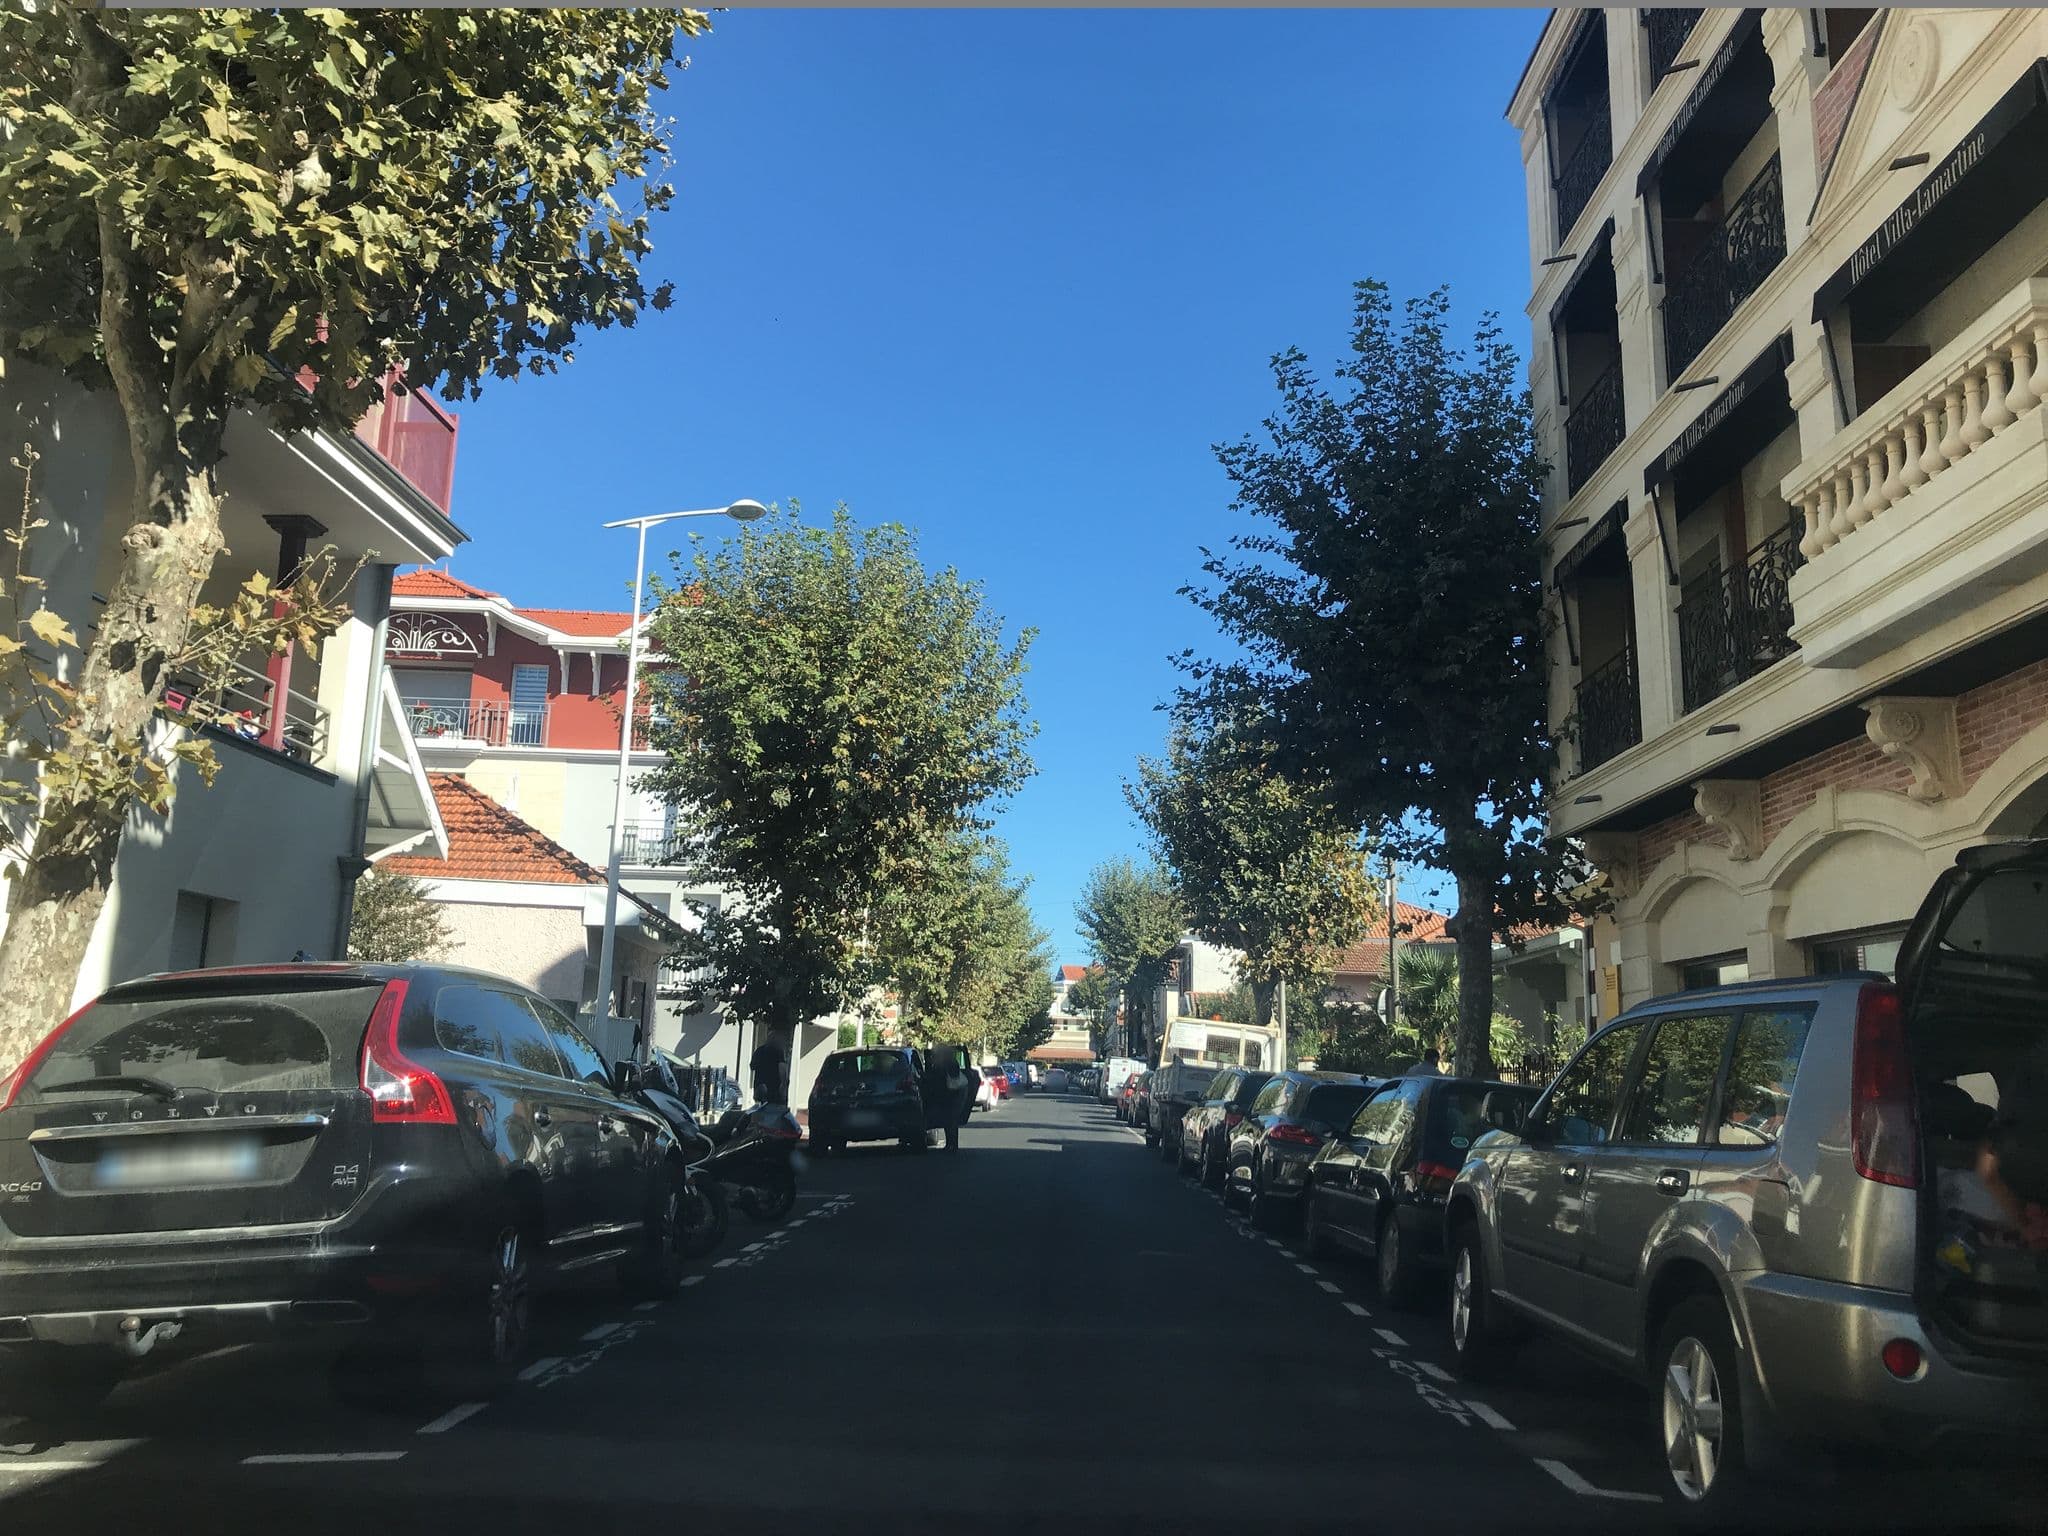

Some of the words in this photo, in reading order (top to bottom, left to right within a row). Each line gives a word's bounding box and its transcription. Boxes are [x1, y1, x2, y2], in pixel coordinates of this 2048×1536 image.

[1850, 231, 1881, 285] Hôtel
[1883, 132, 1985, 248] Villa-Lamartine
[1685, 381, 1745, 450] Villa-Lamartine
[92, 1103, 257, 1122] VOLVO
[333, 1164, 359, 1175] D4
[0, 1181, 42, 1193] XC60
